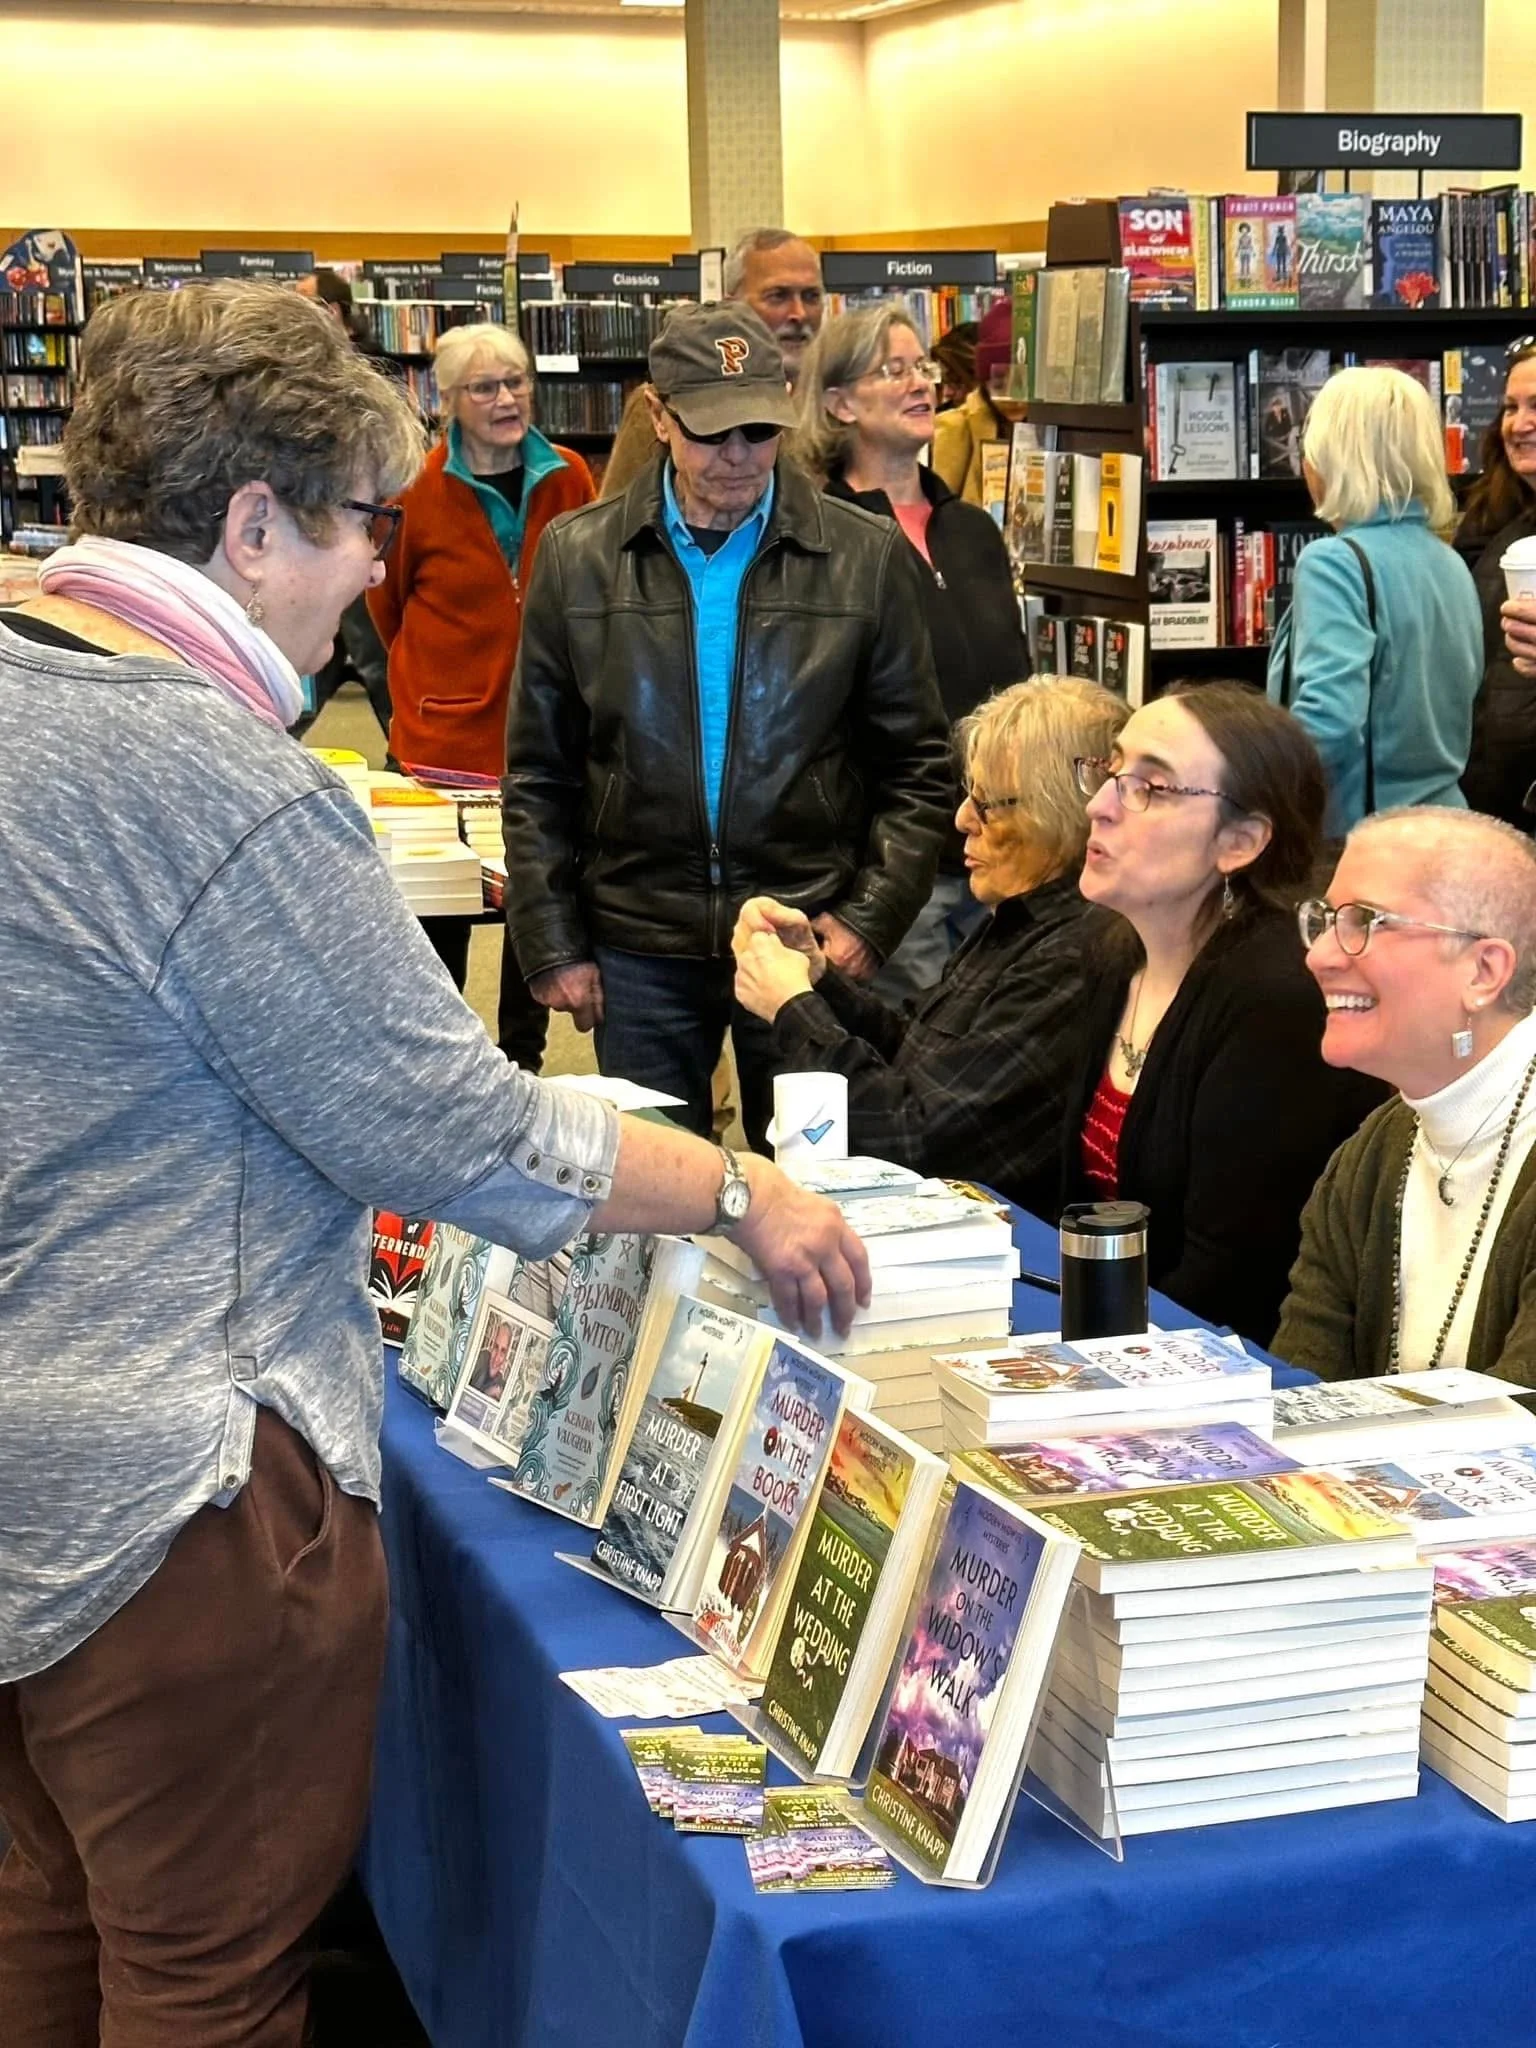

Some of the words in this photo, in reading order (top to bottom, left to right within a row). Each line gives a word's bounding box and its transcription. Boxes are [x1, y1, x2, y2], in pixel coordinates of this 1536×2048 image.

[1337, 129, 1441, 156] Biography
[1129, 209, 1183, 236] SON
[1229, 202, 1259, 213] FRUIT
[1378, 205, 1433, 222] MAYA
[1377, 223, 1434, 234] ANGELOU
[887, 261, 933, 275] Fiction
[1296, 239, 1362, 274] Thirst
[476, 284, 503, 296] Fictio
[613, 273, 660, 286] Classics
[715, 336, 749, 376] P
[1184, 422, 1230, 434] LESSONS
[1189, 410, 1224, 421] HOUSE
[407, 1222, 420, 1234] of
[580, 1312, 625, 1355] WITCH
[1089, 1350, 1146, 1381] BOOKS
[1145, 1361, 1183, 1377] THE
[1155, 1340, 1221, 1374] MURDER
[771, 1390, 825, 1443] MURDER
[646, 1415, 702, 1461] MURDER
[1179, 1434, 1248, 1471] MURDER
[649, 1462, 671, 1487] AT
[789, 1443, 812, 1479] THE
[1484, 1461, 1536, 1494] MURD
[615, 1480, 649, 1514] FIRST
[645, 1497, 683, 1536] LIGHT
[753, 1466, 799, 1516] BOOKS
[1420, 1473, 1481, 1507] BOOKS
[1483, 1485, 1525, 1503] THE
[1128, 1499, 1212, 1553] WEDDING
[1173, 1503, 1214, 1517] AT
[1198, 1519, 1243, 1542] THE
[1208, 1493, 1287, 1541] MURDER
[596, 1540, 638, 1579] CHRISTINE
[634, 1561, 663, 1594] KNAPP
[817, 1529, 873, 1593] MURDER
[950, 1546, 1018, 1613] MURDER
[810, 1574, 833, 1606] AT
[832, 1588, 857, 1629] THE
[956, 1592, 974, 1616] ON
[975, 1604, 994, 1632] THE
[793, 1602, 850, 1676] WEDDING
[928, 1604, 1002, 1682] WIDOW'S
[930, 1659, 976, 1719] WALK
[768, 1699, 801, 1742] CHRISTINE
[798, 1730, 818, 1761] KNAPP
[690, 1790, 753, 1798] MURDER
[872, 1784, 917, 1835] CHRISTINE
[915, 1822, 945, 1861] KNAPP
